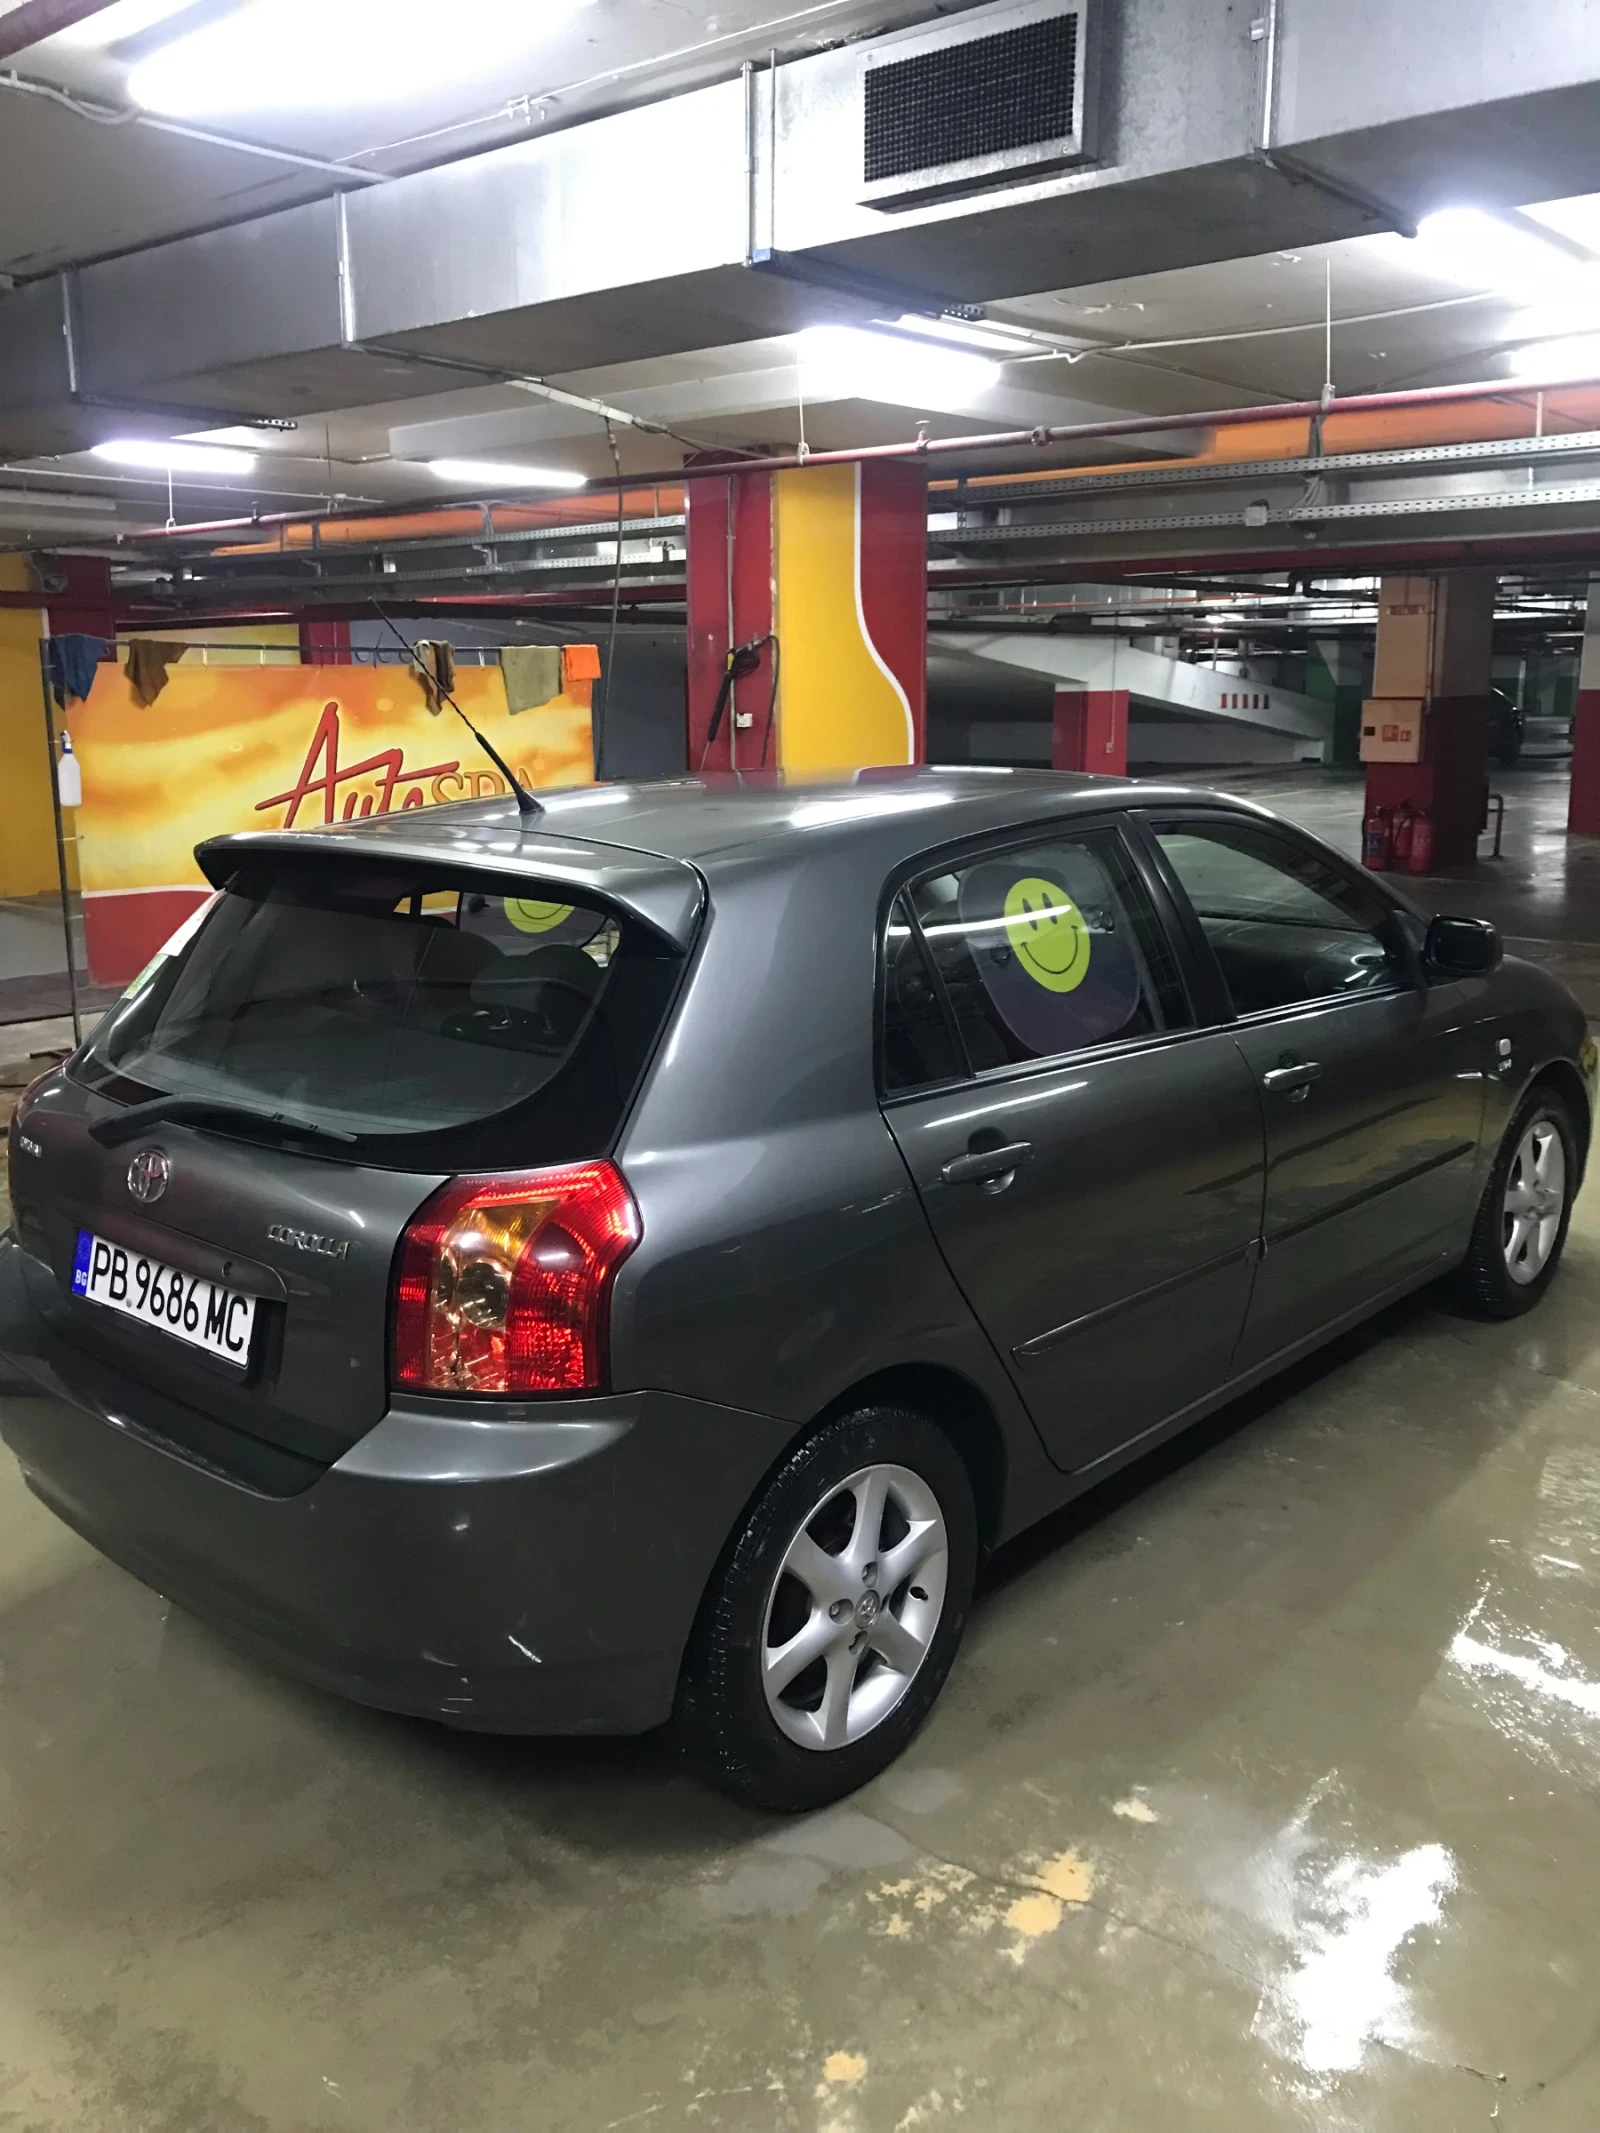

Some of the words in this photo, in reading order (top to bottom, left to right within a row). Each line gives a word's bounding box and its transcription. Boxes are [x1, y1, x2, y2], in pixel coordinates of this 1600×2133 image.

[267, 1224, 349, 1260] COROLLA
[75, 1269, 88, 1286] BG
[90, 1241, 128, 1301] PB
[136, 1259, 199, 1332] 9686
[204, 1285, 248, 1352] MC
